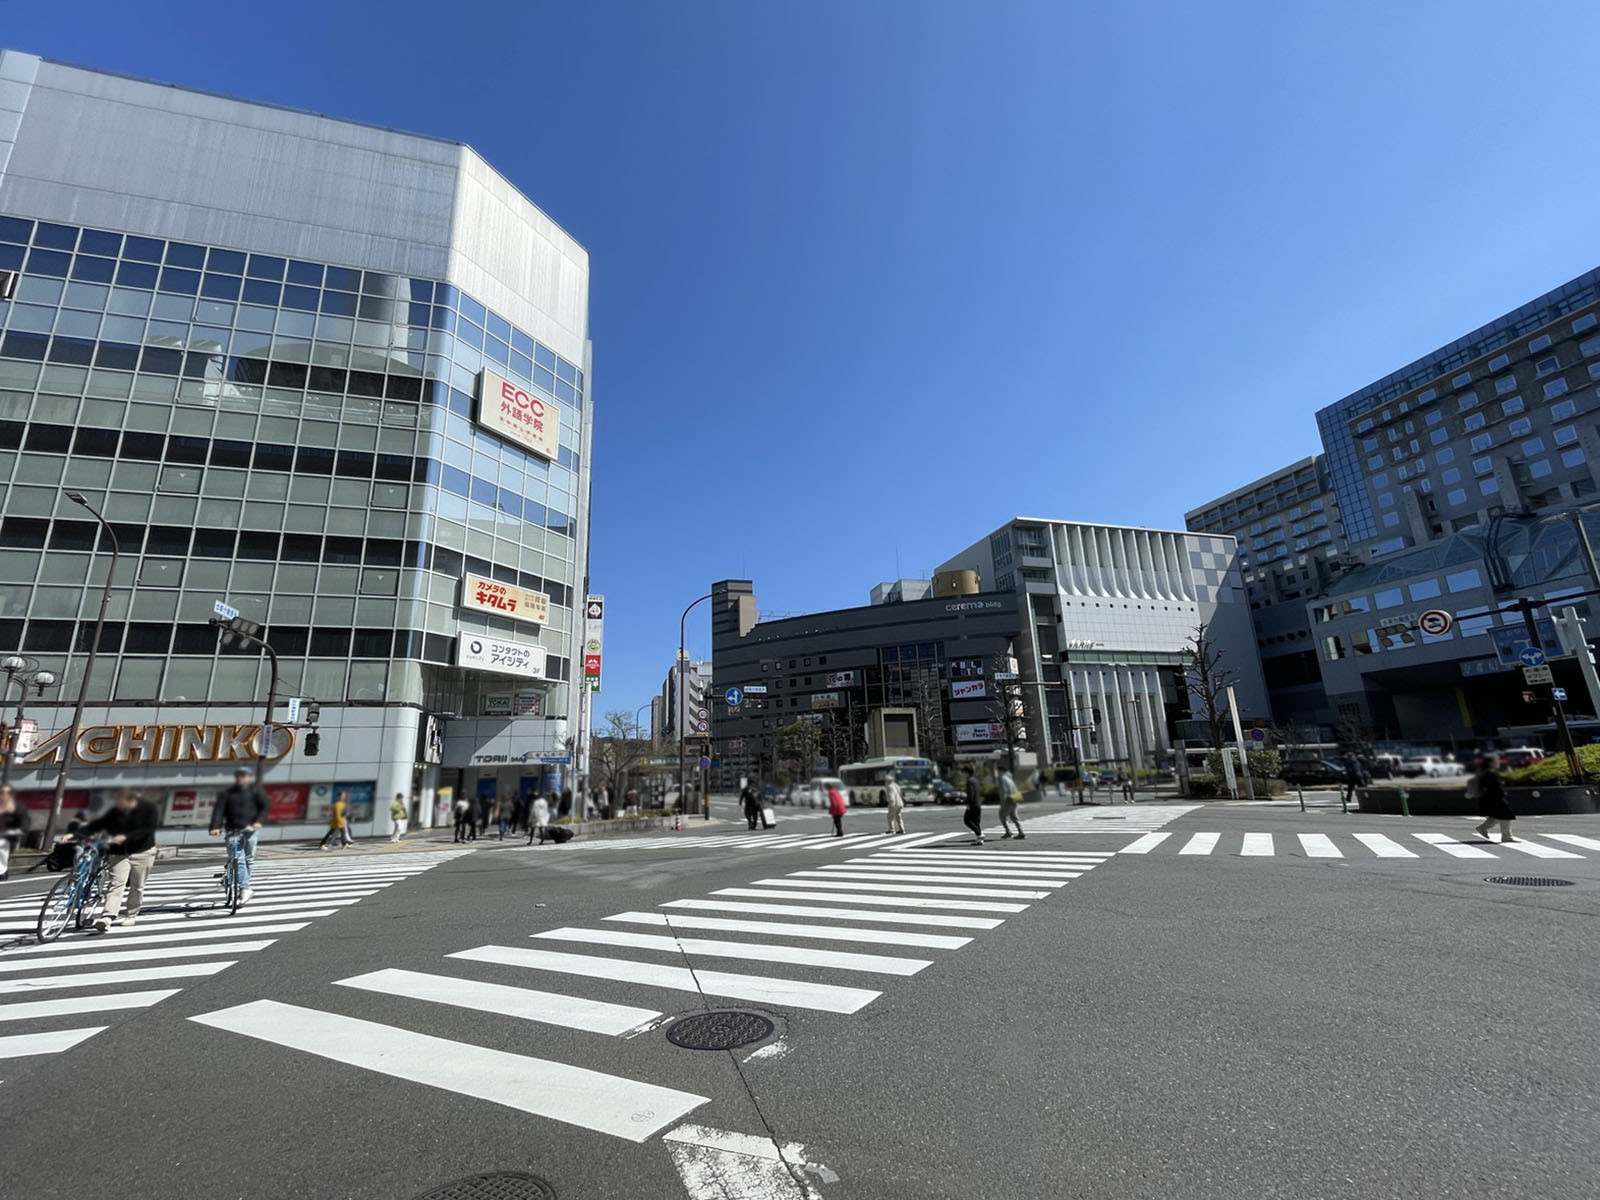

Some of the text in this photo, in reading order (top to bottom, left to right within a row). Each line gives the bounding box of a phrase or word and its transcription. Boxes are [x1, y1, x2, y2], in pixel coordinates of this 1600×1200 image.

[501, 381, 545, 418] ECC
[500, 401, 544, 433] 外語学院
[477, 581, 507, 596] カメラの
[475, 591, 517, 612] キタムラ
[491, 644, 531, 658] コンタクトの
[491, 653, 530, 669] アイシティ
[954, 682, 984, 696] ジャンカラ
[0, 724, 295, 764] ACHINKO
[475, 754, 508, 763] TORII
